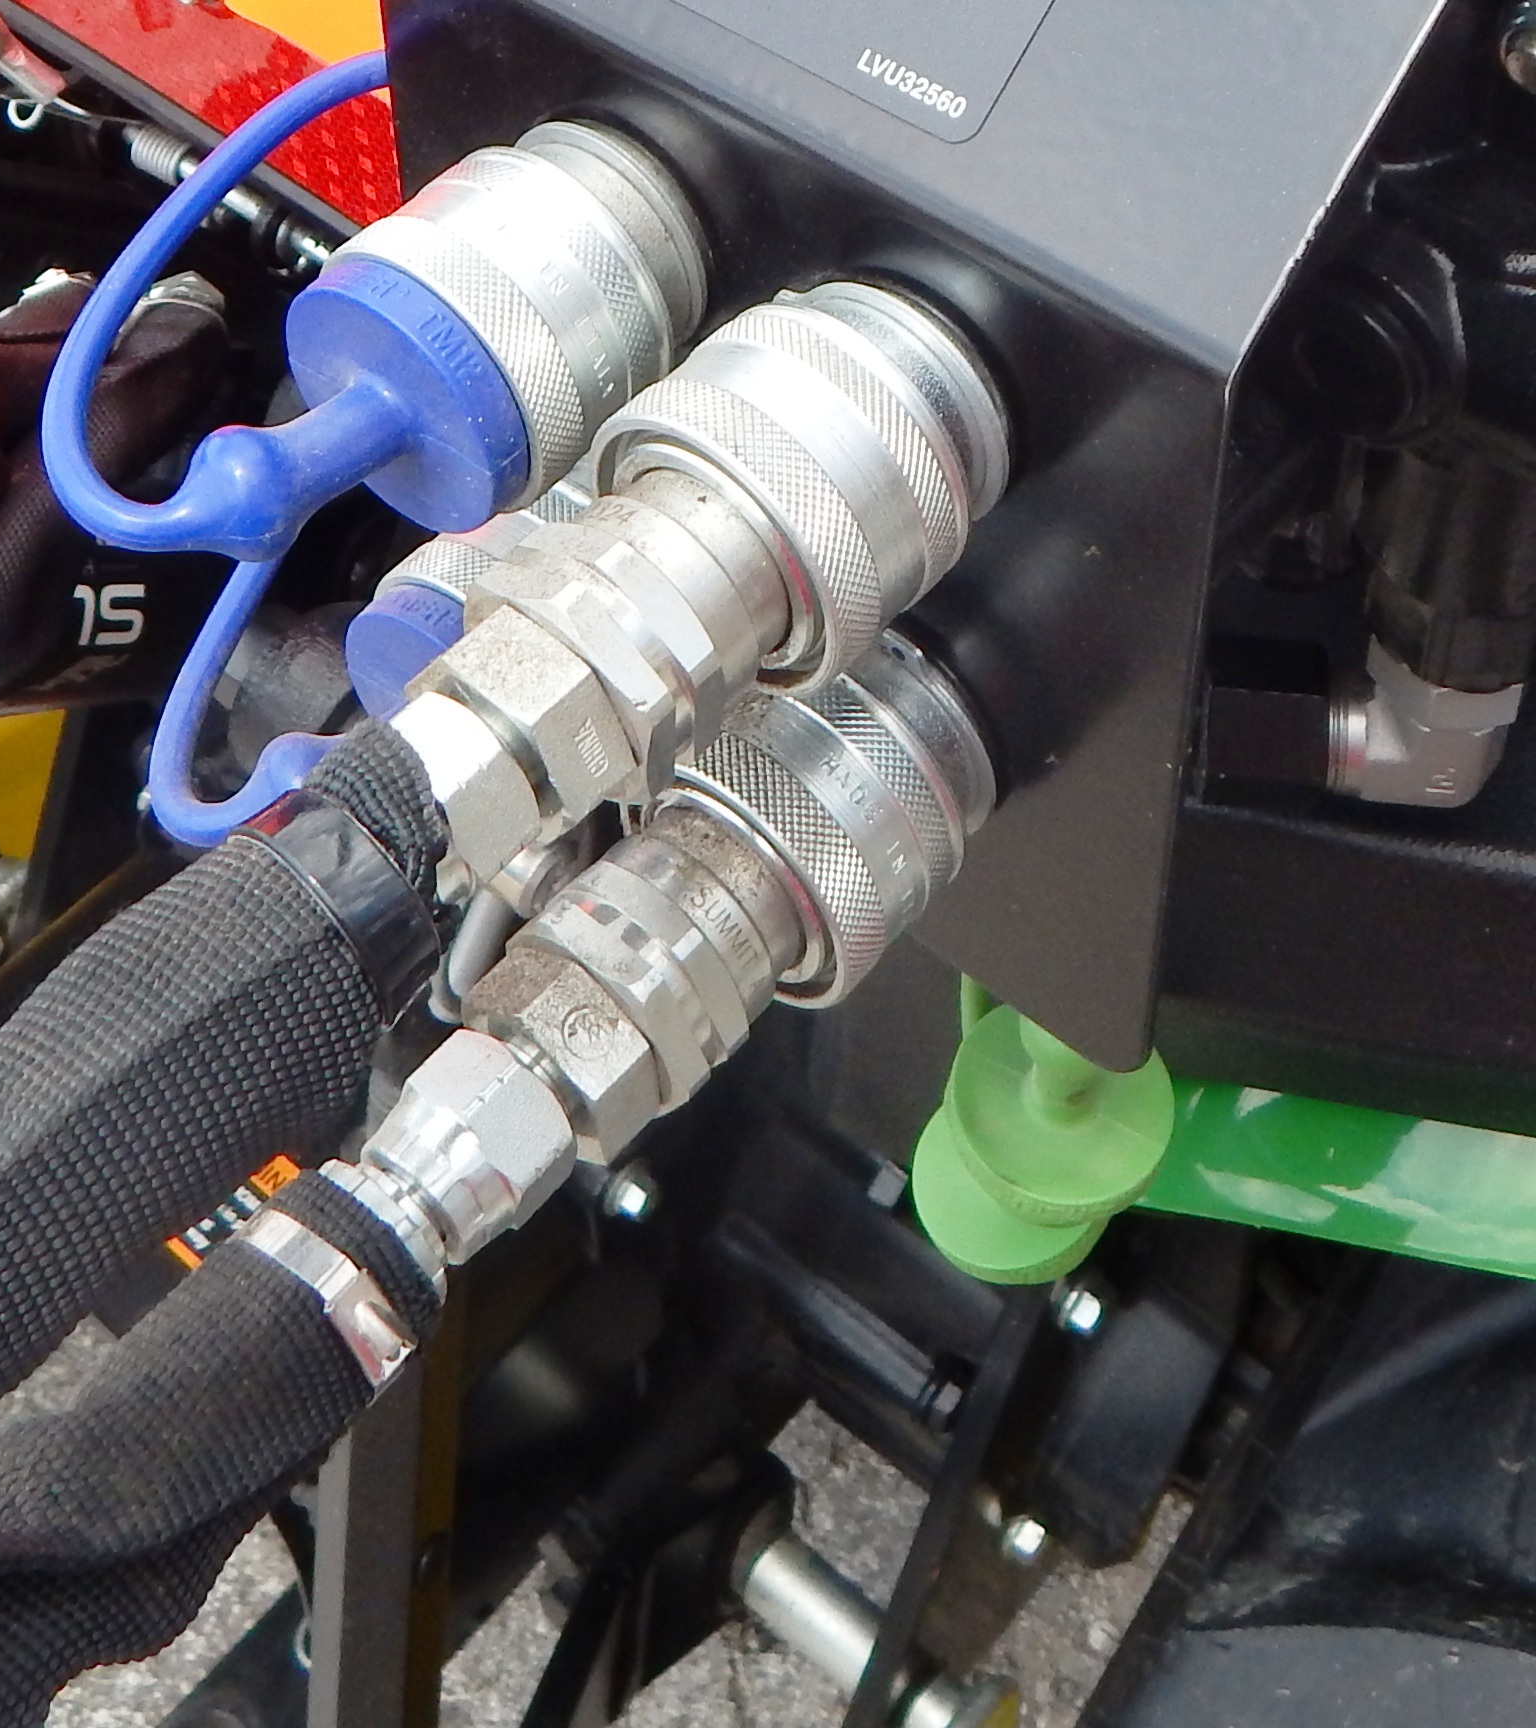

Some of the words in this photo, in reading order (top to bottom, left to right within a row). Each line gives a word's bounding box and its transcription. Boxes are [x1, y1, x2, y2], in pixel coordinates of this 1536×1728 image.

[855, 45, 968, 119] LVU32560
[574, 716, 609, 778] CHINA
[690, 884, 759, 969] SUMMIT
